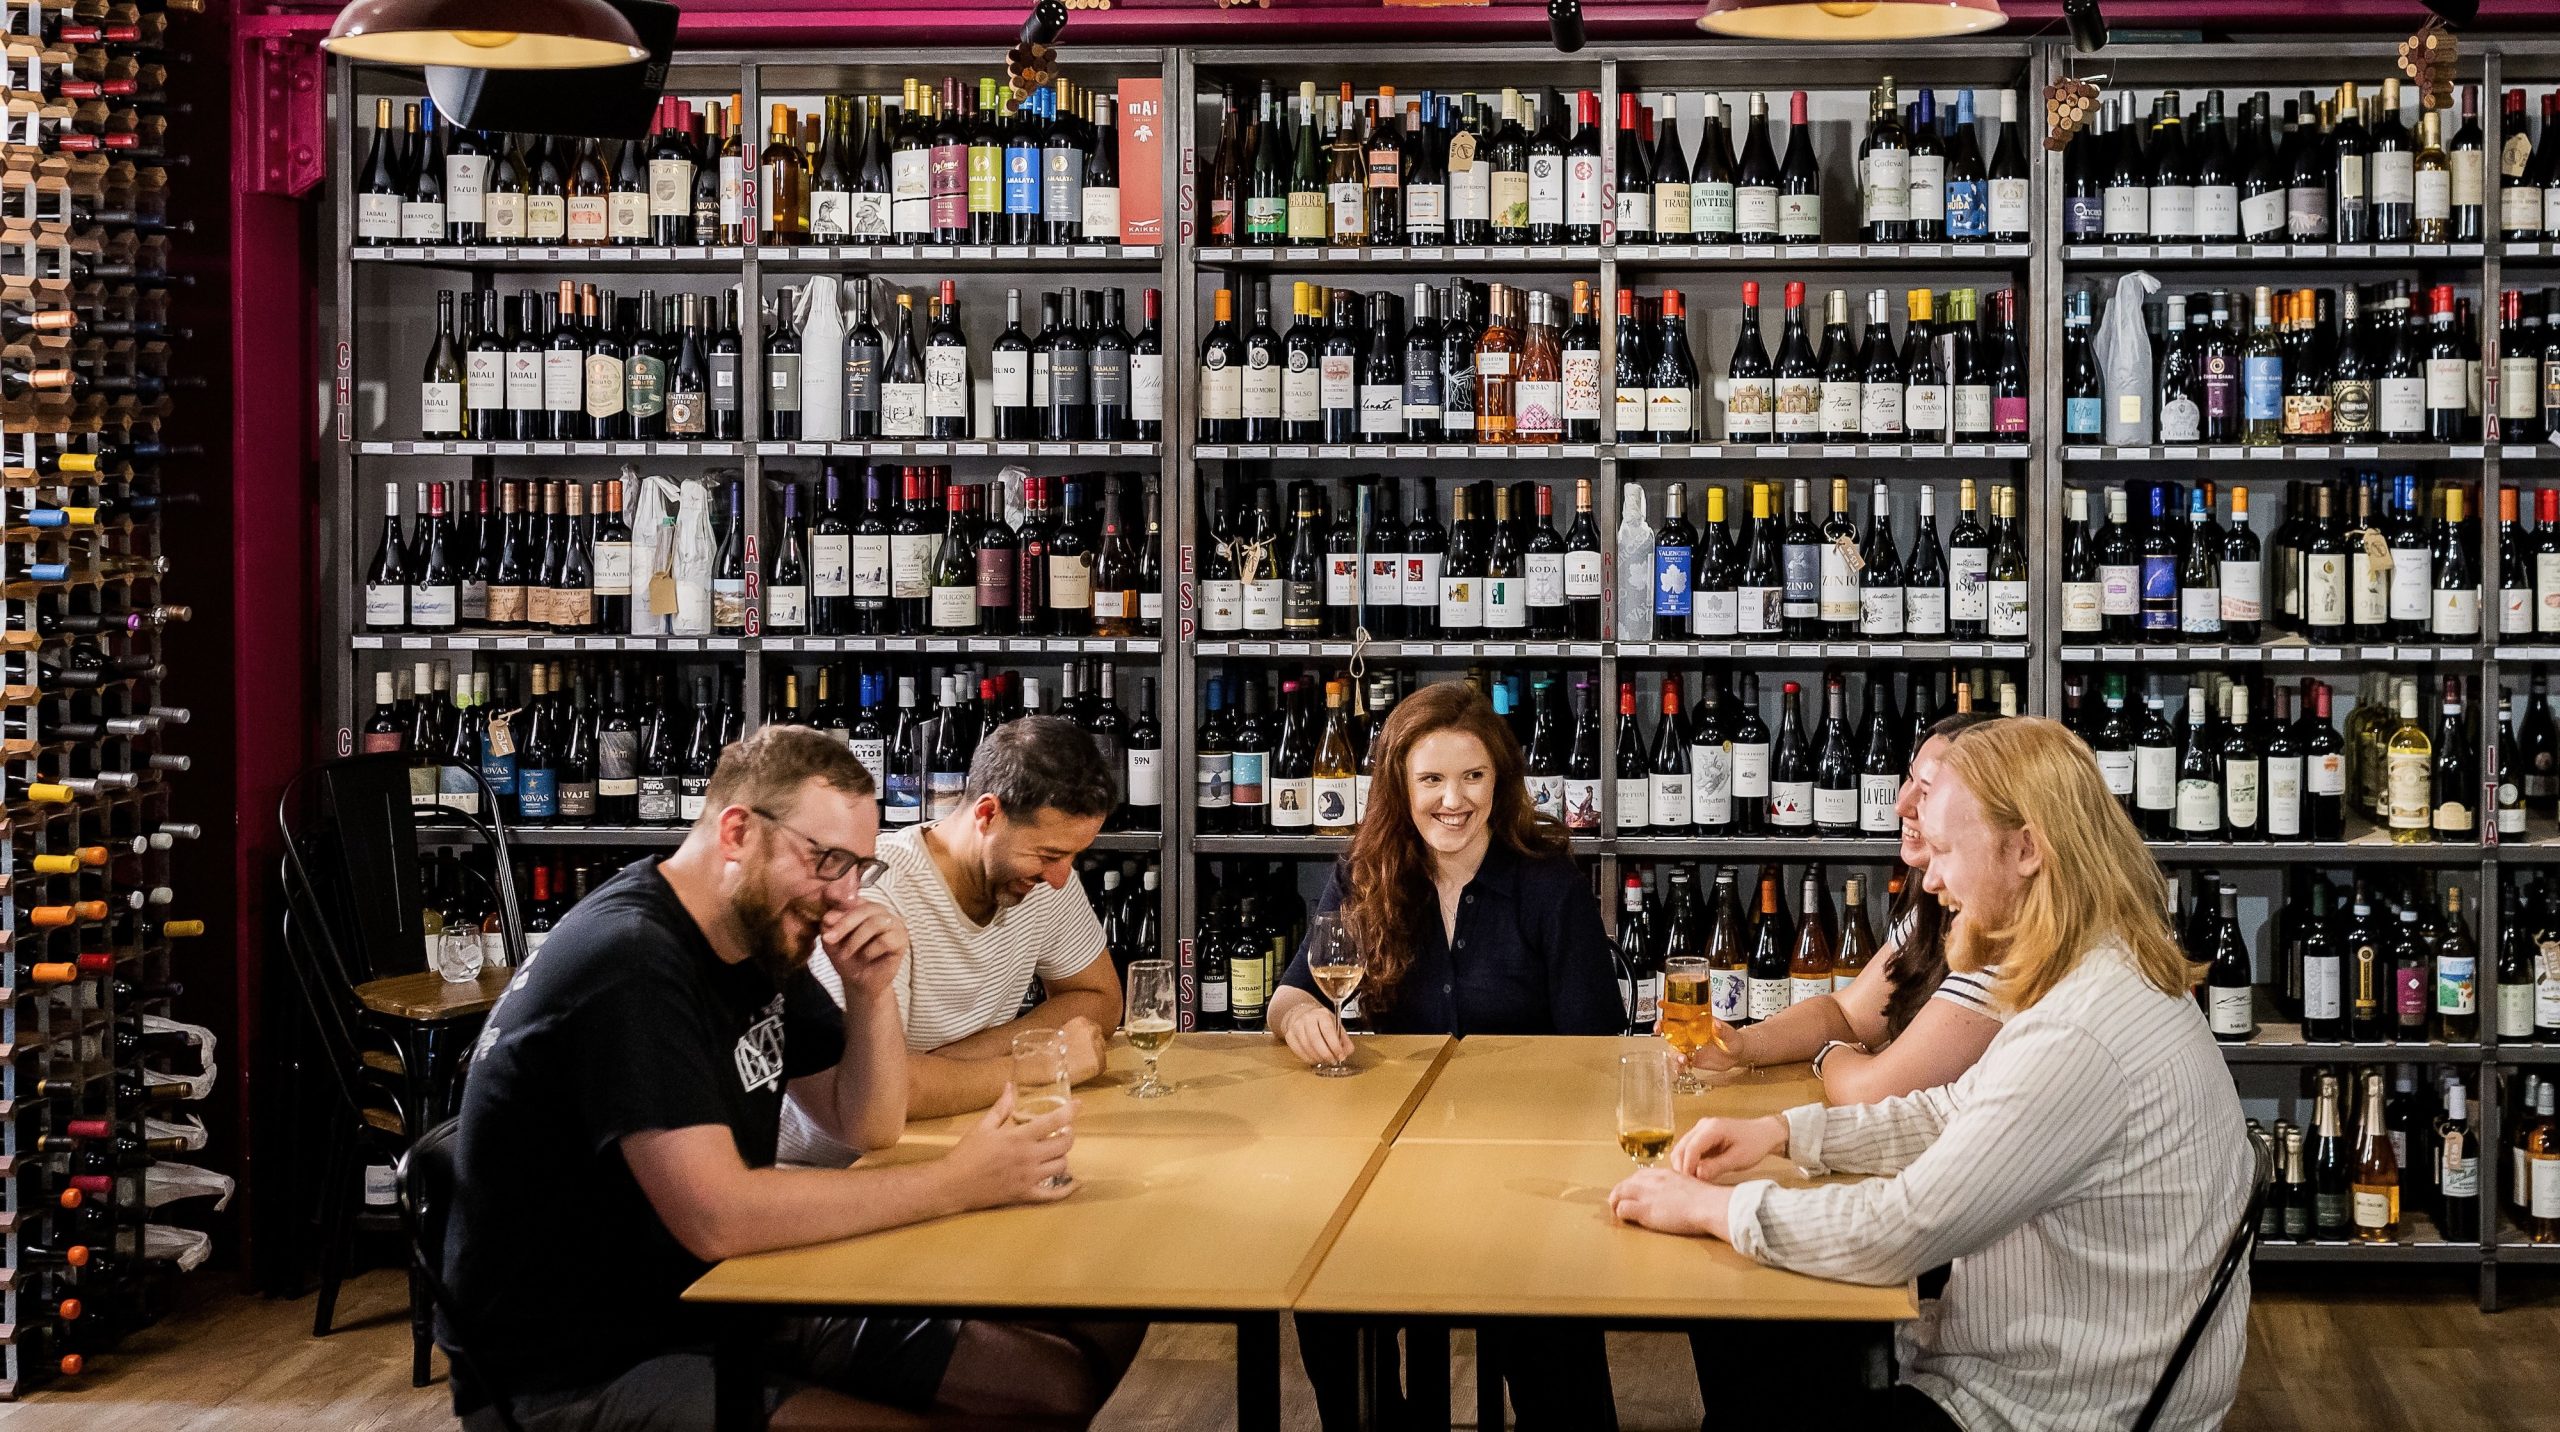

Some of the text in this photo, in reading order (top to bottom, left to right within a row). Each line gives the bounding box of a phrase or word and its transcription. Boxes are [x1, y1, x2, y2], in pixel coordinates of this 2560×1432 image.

[1128, 100, 1158, 115] mAi
[1874, 159, 1904, 168] Godeval
[741, 142, 757, 246] URU
[1180, 147, 1195, 246] ESP
[1951, 193, 1963, 202] LA
[1947, 201, 1970, 210] HUIDA
[336, 341, 351, 442] CHL
[2484, 340, 2499, 440] ITA
[1568, 572, 1580, 583] LUIS
[1823, 575, 1857, 587] ZINIO
[745, 534, 760, 638] ARG
[1180, 545, 1194, 642] ESP
[1786, 582, 1814, 590] ZINIO
[1253, 595, 1280, 603] Ancestral
[1602, 551, 1613, 640] RIOJA
[1134, 756, 1149, 765] 59N
[520, 793, 549, 801] NOVAS
[1863, 788, 1897, 805] LA VELLA
[2484, 745, 2499, 841] ITA
[1180, 938, 1195, 1034] ESP
